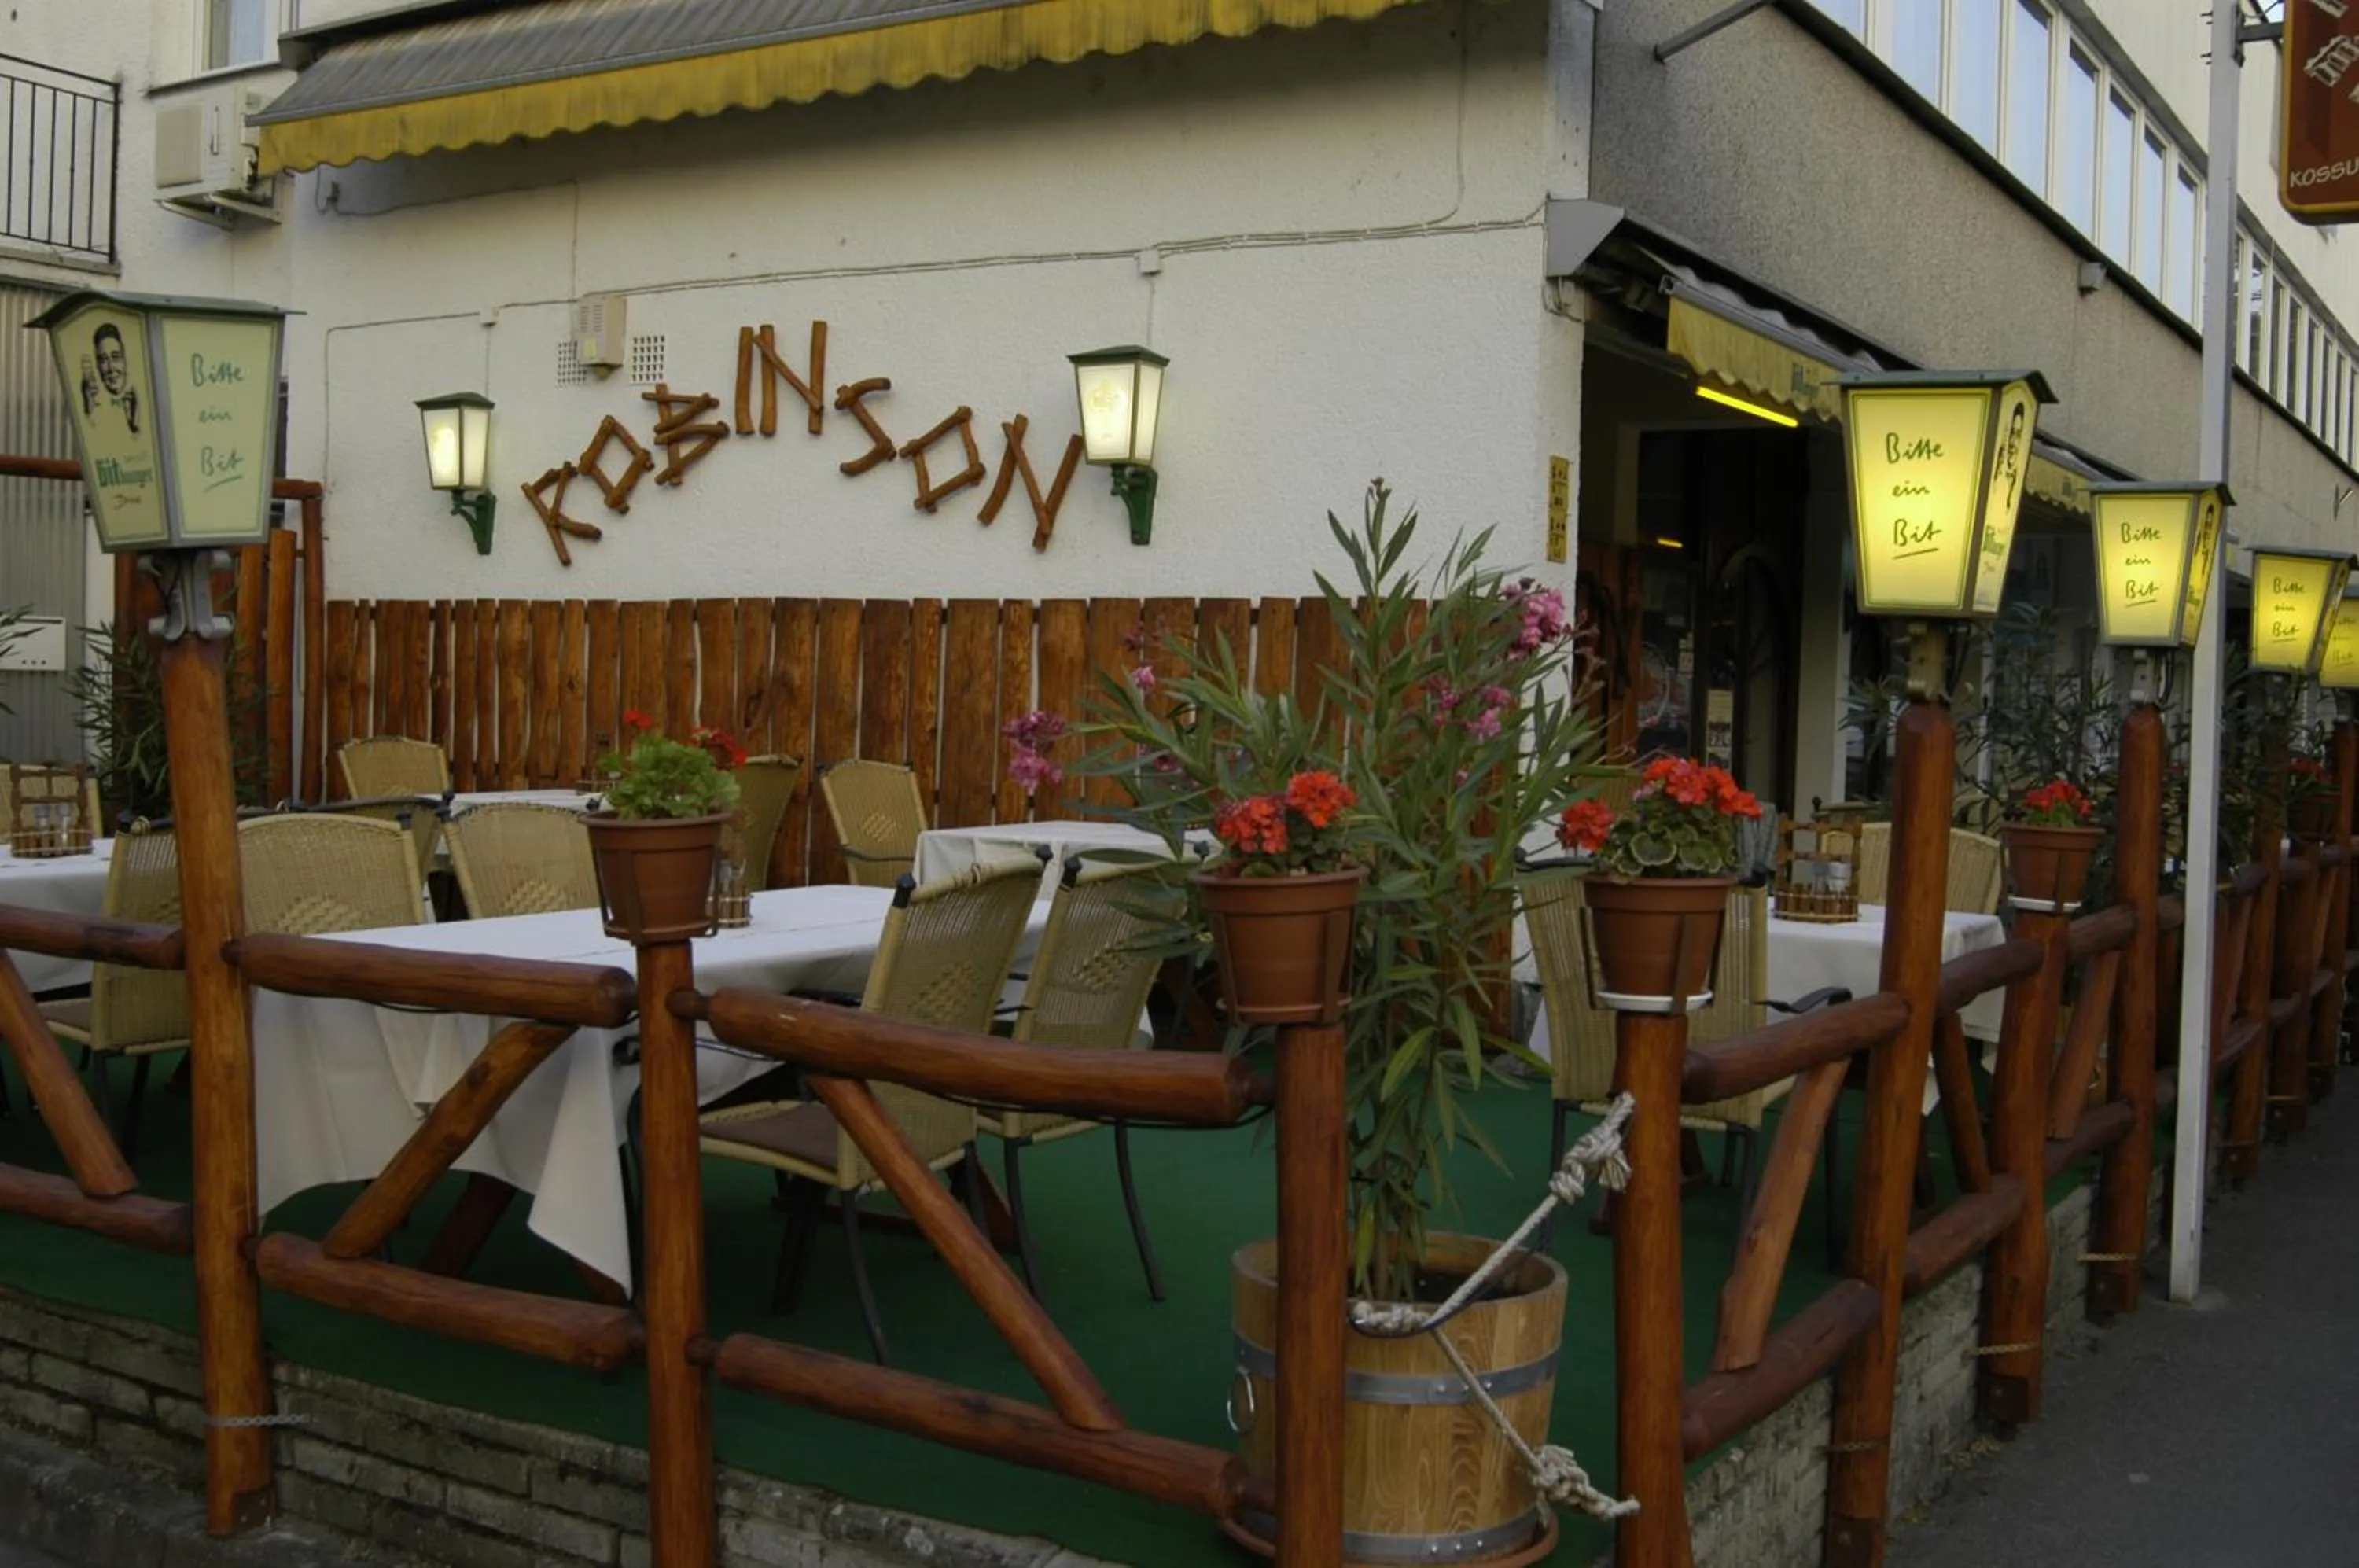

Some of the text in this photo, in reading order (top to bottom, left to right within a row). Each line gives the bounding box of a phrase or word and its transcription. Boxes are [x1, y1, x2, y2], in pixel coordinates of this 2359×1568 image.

[191, 352, 244, 387] Bitte
[199, 405, 232, 423] ein
[521, 321, 1084, 566] ROBINSON
[1886, 432, 1945, 464] Bitte
[201, 446, 244, 477] Bit
[1891, 480, 1930, 497] ein
[1893, 518, 1943, 547] Bit
[2120, 522, 2162, 543] Bitte
[2125, 555, 2151, 565] ein
[2125, 579, 2159, 598] Bit
